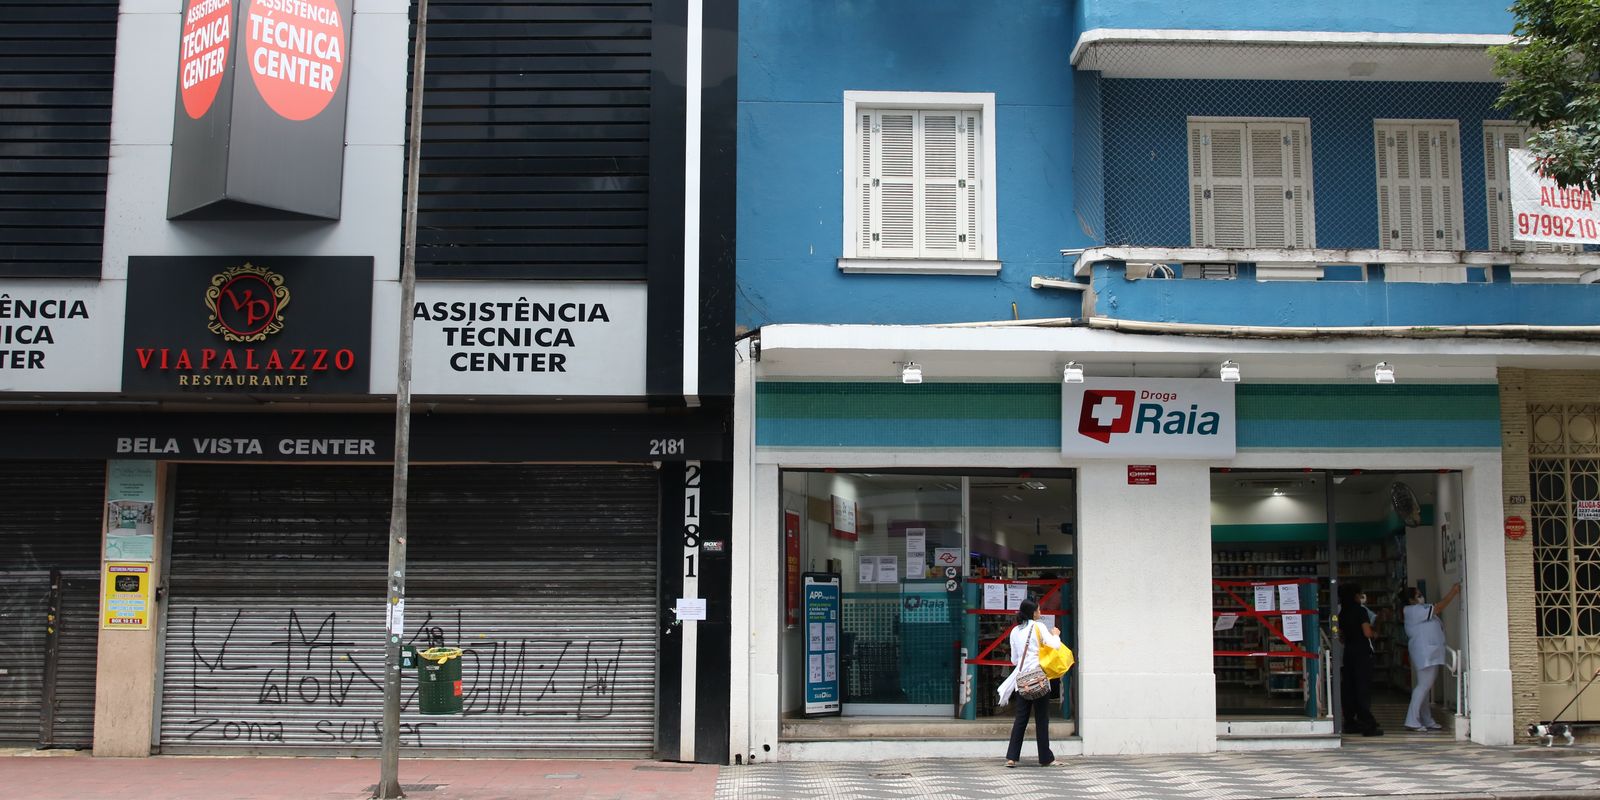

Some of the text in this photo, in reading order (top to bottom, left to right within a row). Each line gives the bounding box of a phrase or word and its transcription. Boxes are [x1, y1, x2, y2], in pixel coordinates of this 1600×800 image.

[183, 15, 230, 60] TÉCNICA
[250, 11, 341, 62] TÉCNICA
[183, 47, 224, 90] CENTER
[254, 47, 334, 92] CENTER
[1540, 186, 1593, 211] ALUGA
[1518, 213, 1600, 239] 9799210
[0, 294, 89, 319] ÊNCIA
[413, 297, 610, 322] ASSISTÊNCIA
[0, 325, 54, 345] ICA
[443, 321, 575, 348] TÉCNICA
[450, 352, 567, 372] CENTER
[179, 374, 309, 386] RESTAURANTE
[1141, 390, 1177, 402] Droga
[1135, 403, 1220, 435] Raia
[116, 438, 376, 455] BELA VISTA CENTER
[650, 438, 685, 455] 2181
[809, 591, 823, 600] APP
[920, 600, 945, 609] Raia
